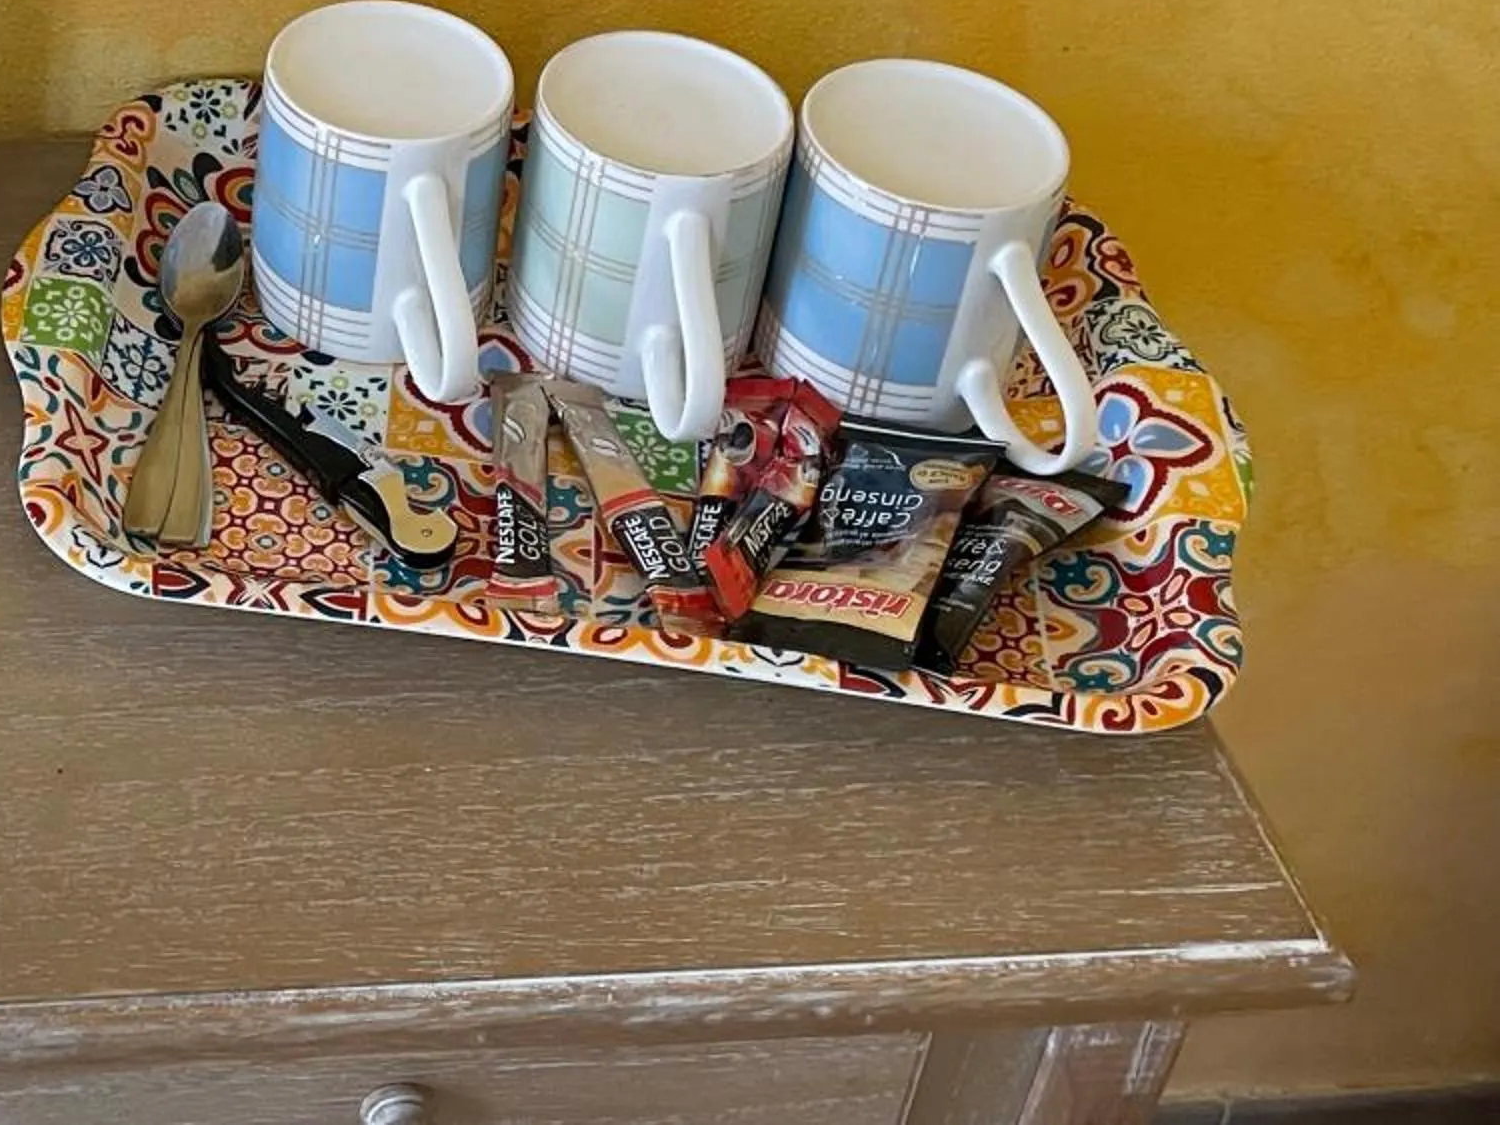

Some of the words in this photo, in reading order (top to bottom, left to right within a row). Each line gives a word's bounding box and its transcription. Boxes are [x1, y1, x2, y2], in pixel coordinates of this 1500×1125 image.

[820, 481, 924, 511] Ginseng
[841, 507, 911, 528] Caffè
[649, 516, 691, 572] GOLD
[764, 578, 913, 620] ristora
